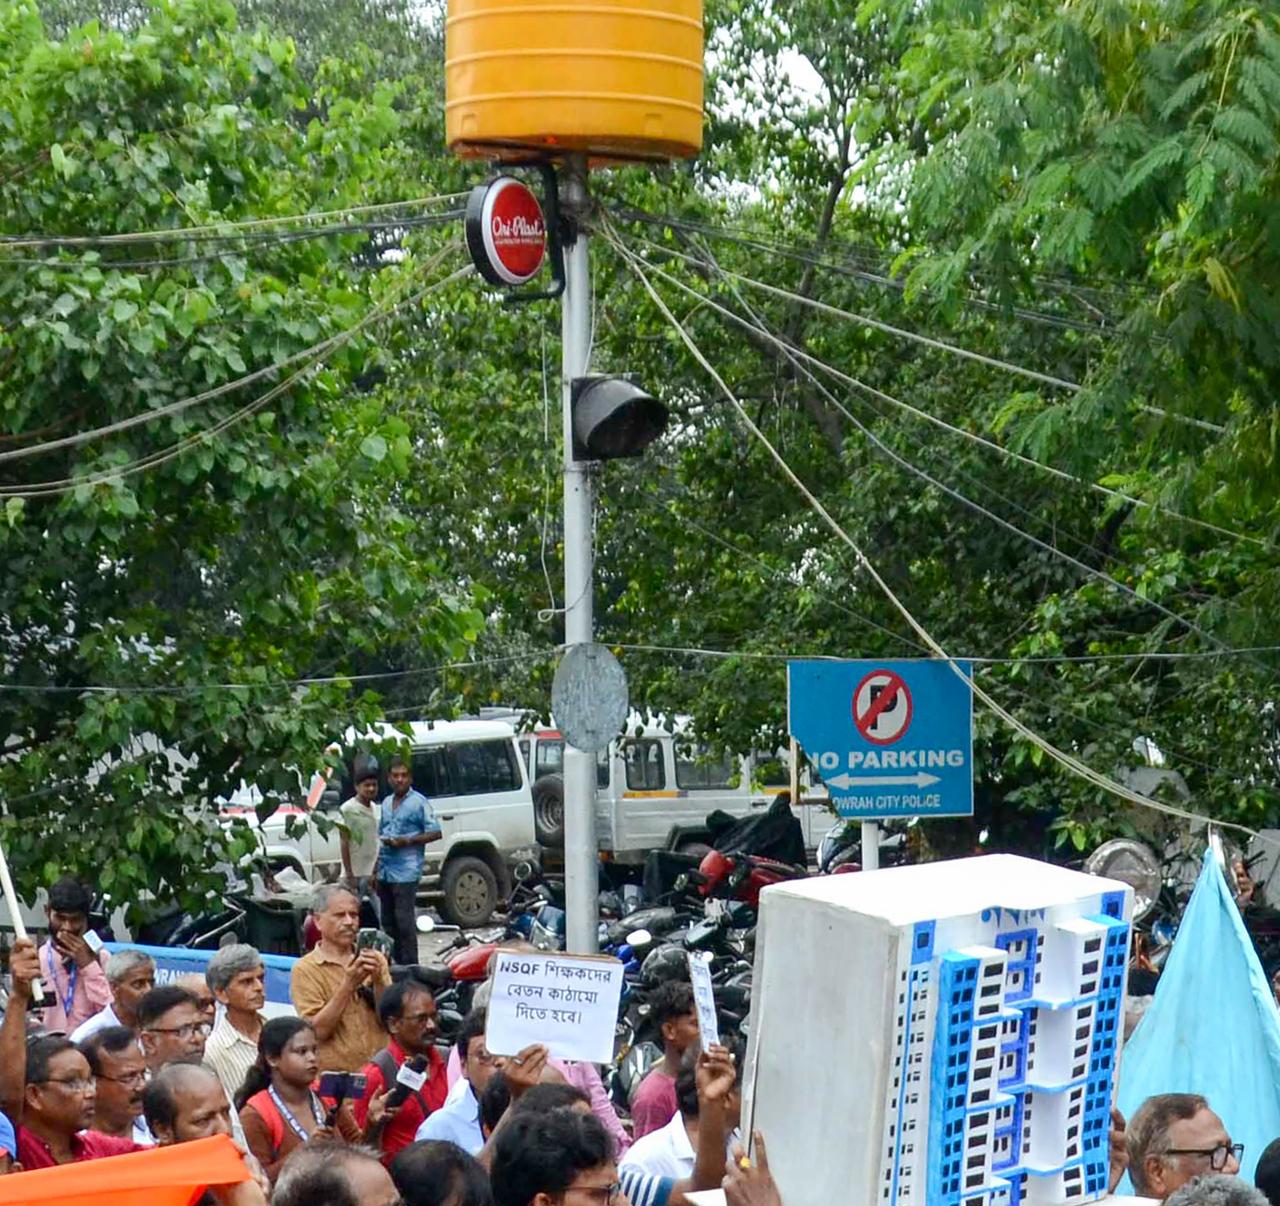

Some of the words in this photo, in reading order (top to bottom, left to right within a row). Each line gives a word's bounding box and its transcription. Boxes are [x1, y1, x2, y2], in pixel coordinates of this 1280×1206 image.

[848, 749, 964, 769] PARKING
[831, 796, 873, 811] OWRAH
[876, 795, 901, 809] CITY
[902, 793, 941, 808] POLICE
[500, 960, 540, 976] NSQF
[544, 961, 612, 984] শিক্ষকদের
[507, 984, 544, 1000] বেতন
[548, 987, 598, 1005] কাঠামো
[516, 1002, 549, 1021] দিতে
